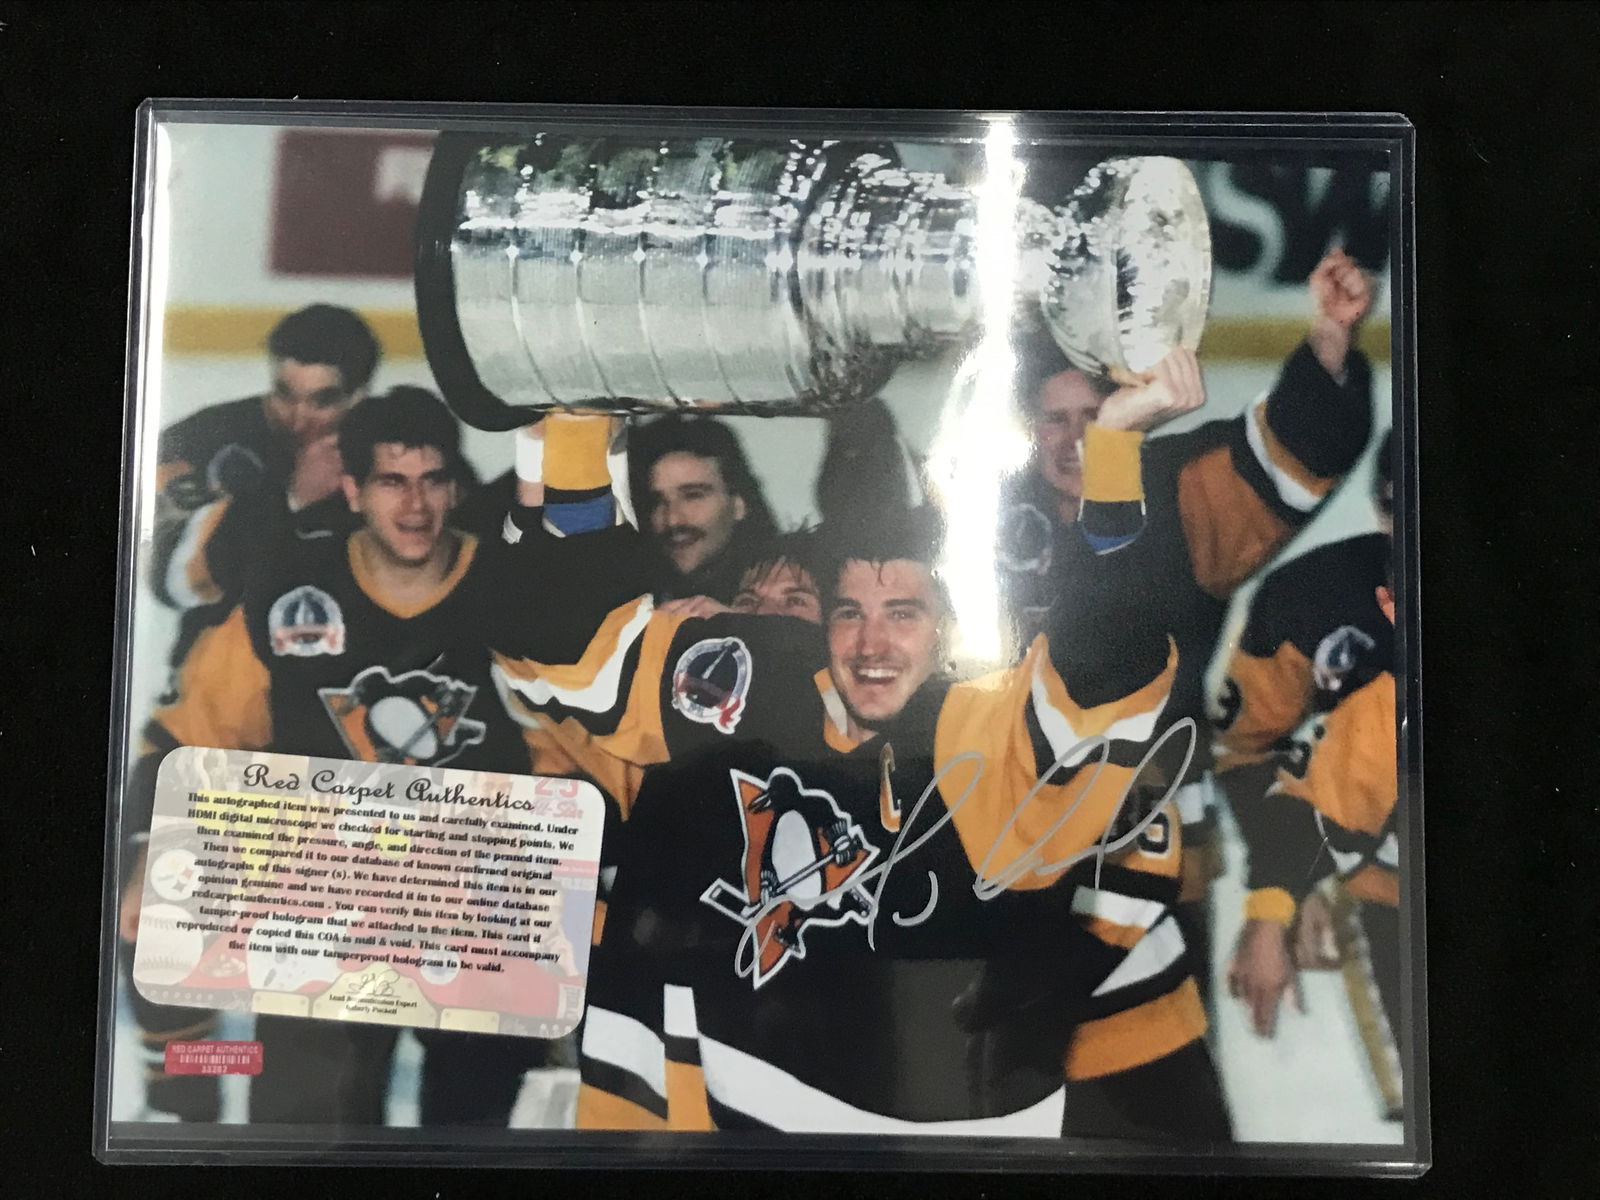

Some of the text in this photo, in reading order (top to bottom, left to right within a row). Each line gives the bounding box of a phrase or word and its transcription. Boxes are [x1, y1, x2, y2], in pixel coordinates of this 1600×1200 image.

[243, 763, 535, 811] Red Carpet Authentics
[187, 808, 575, 851] HDMI digital microscope we checked for starting and stopping points. We
[188, 792, 579, 835] This autographed item was presented to us and carefully examined. Under
[196, 825, 563, 867] then examined the pressure, angle, and direction of the penned item.
[203, 841, 229, 853] Then
[232, 845, 247, 854] we
[249, 847, 303, 861] compared
[305, 850, 314, 860] it
[316, 852, 328, 861] to
[330, 855, 349, 863] our
[351, 854, 400, 867] database
[402, 859, 415, 869] of
[416, 859, 452, 872] known
[454, 864, 509, 877] confirmed
[510, 868, 553, 881] original
[197, 875, 550, 912] opinion genuine and we have recorded it in to our online database
[258, 862, 271, 873] of
[272, 863, 292, 874] this
[295, 866, 330, 878] signer
[353, 870, 369, 881] We
[371, 872, 397, 883] have
[399, 874, 460, 889] determined
[463, 880, 484, 891] this
[486, 881, 510, 893] item
[512, 884, 522, 894] is
[524, 885, 536, 895] in
[538, 888, 558, 897] our
[271, 911, 324, 925] hologram
[326, 916, 348, 927] that
[350, 920, 365, 929] we
[367, 920, 414, 933] attached
[417, 924, 428, 934] to
[431, 925, 448, 936] the
[450, 927, 478, 938] item.
[481, 928, 503, 940] This
[506, 932, 531, 943] card
[533, 933, 542, 944] if
[335, 900, 355, 911] You
[357, 905, 377, 914] can
[379, 906, 410, 918] verify
[412, 907, 433, 918] this
[435, 909, 459, 920] item
[462, 911, 475, 924] by
[476, 912, 517, 928] looking
[519, 917, 531, 927] at
[533, 920, 553, 929] our
[176, 921, 238, 934] reproduced
[241, 927, 253, 935] or
[256, 928, 292, 939] copied
[294, 929, 315, 940] this
[317, 931, 340, 943] COA
[342, 933, 352, 944] is
[354, 936, 376, 946] null
[419, 940, 441, 951] This
[444, 944, 469, 954] card
[470, 946, 498, 956] must
[500, 949, 561, 964] accompany
[228, 940, 505, 973] the item with our tamperproof hologram to be valid.
